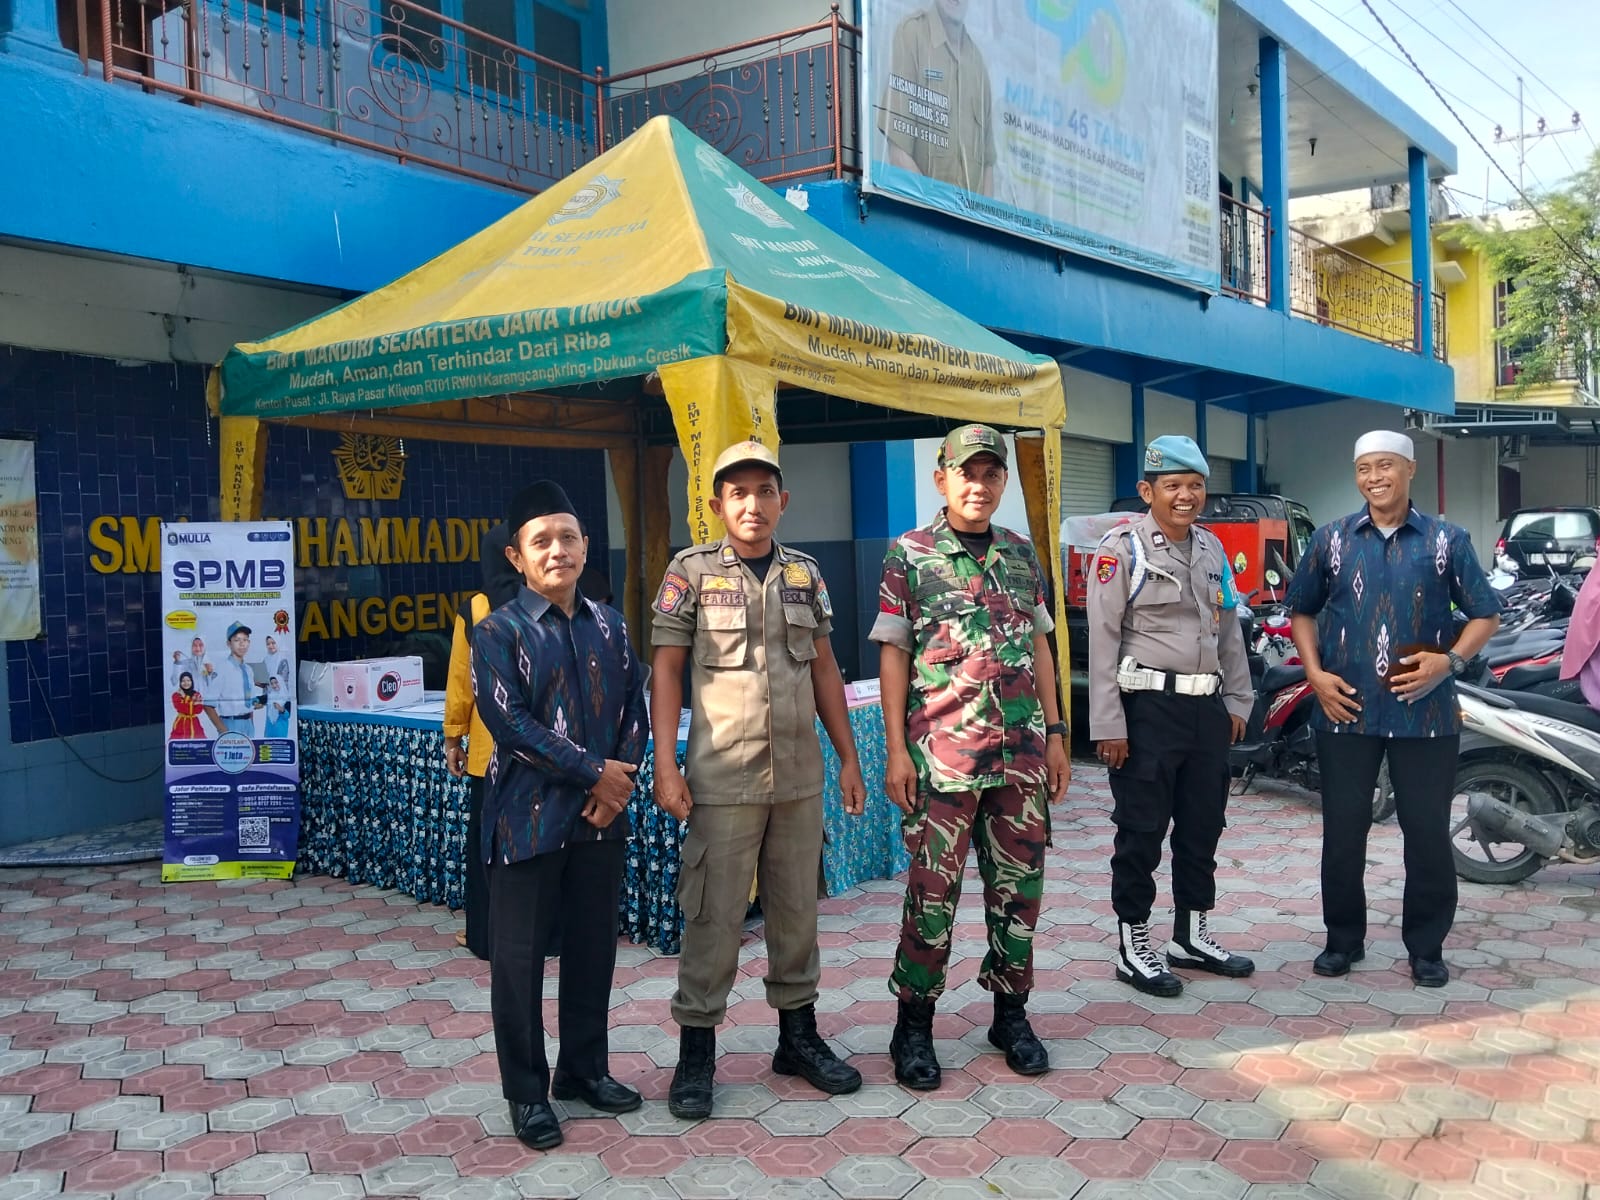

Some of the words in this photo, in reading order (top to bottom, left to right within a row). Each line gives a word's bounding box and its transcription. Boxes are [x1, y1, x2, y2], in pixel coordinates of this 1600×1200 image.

[893, 119, 919, 138] KEPALA
[920, 129, 950, 150] SEKOLAH
[1003, 111, 1023, 130] SMA
[1004, 77, 1064, 128] MILAD
[1067, 109, 1089, 140] 46
[1094, 118, 1146, 164] TAHUN
[304, 336, 376, 366] MANDIRI
[377, 317, 494, 355] SEJAHTERA
[497, 306, 560, 338] JAWA
[568, 296, 643, 326] TIMUR
[783, 302, 821, 329] BMT
[828, 313, 894, 351] MANDIRI
[896, 332, 972, 370] SEJAHTERA
[973, 352, 1006, 377] JAWA
[1005, 359, 1038, 381] TIMUR
[285, 395, 311, 410] Pusat
[332, 390, 356, 407] Raya
[357, 387, 386, 402] Pasar
[388, 382, 424, 399] Kliwon
[424, 379, 450, 394] RT01
[593, 353, 637, 374] Dukun
[645, 342, 692, 365] Gresik
[289, 370, 339, 390] Mudah,
[427, 346, 515, 372] Terhindar
[518, 336, 559, 361] Dari
[563, 330, 612, 354] Riba
[808, 333, 863, 369] Mudah,
[932, 366, 981, 391] Terhindar
[979, 377, 998, 395] Dari
[999, 381, 1022, 398] Riba
[687, 402, 701, 427] BMT
[235, 441, 245, 459] BMT
[691, 431, 702, 491] MANDIRI
[88, 515, 161, 574] SM
[178, 532, 212, 544] MULIA
[172, 559, 286, 590] SPMB
[381, 680, 398, 693] Cleo
[228, 750, 243, 760] Juta
